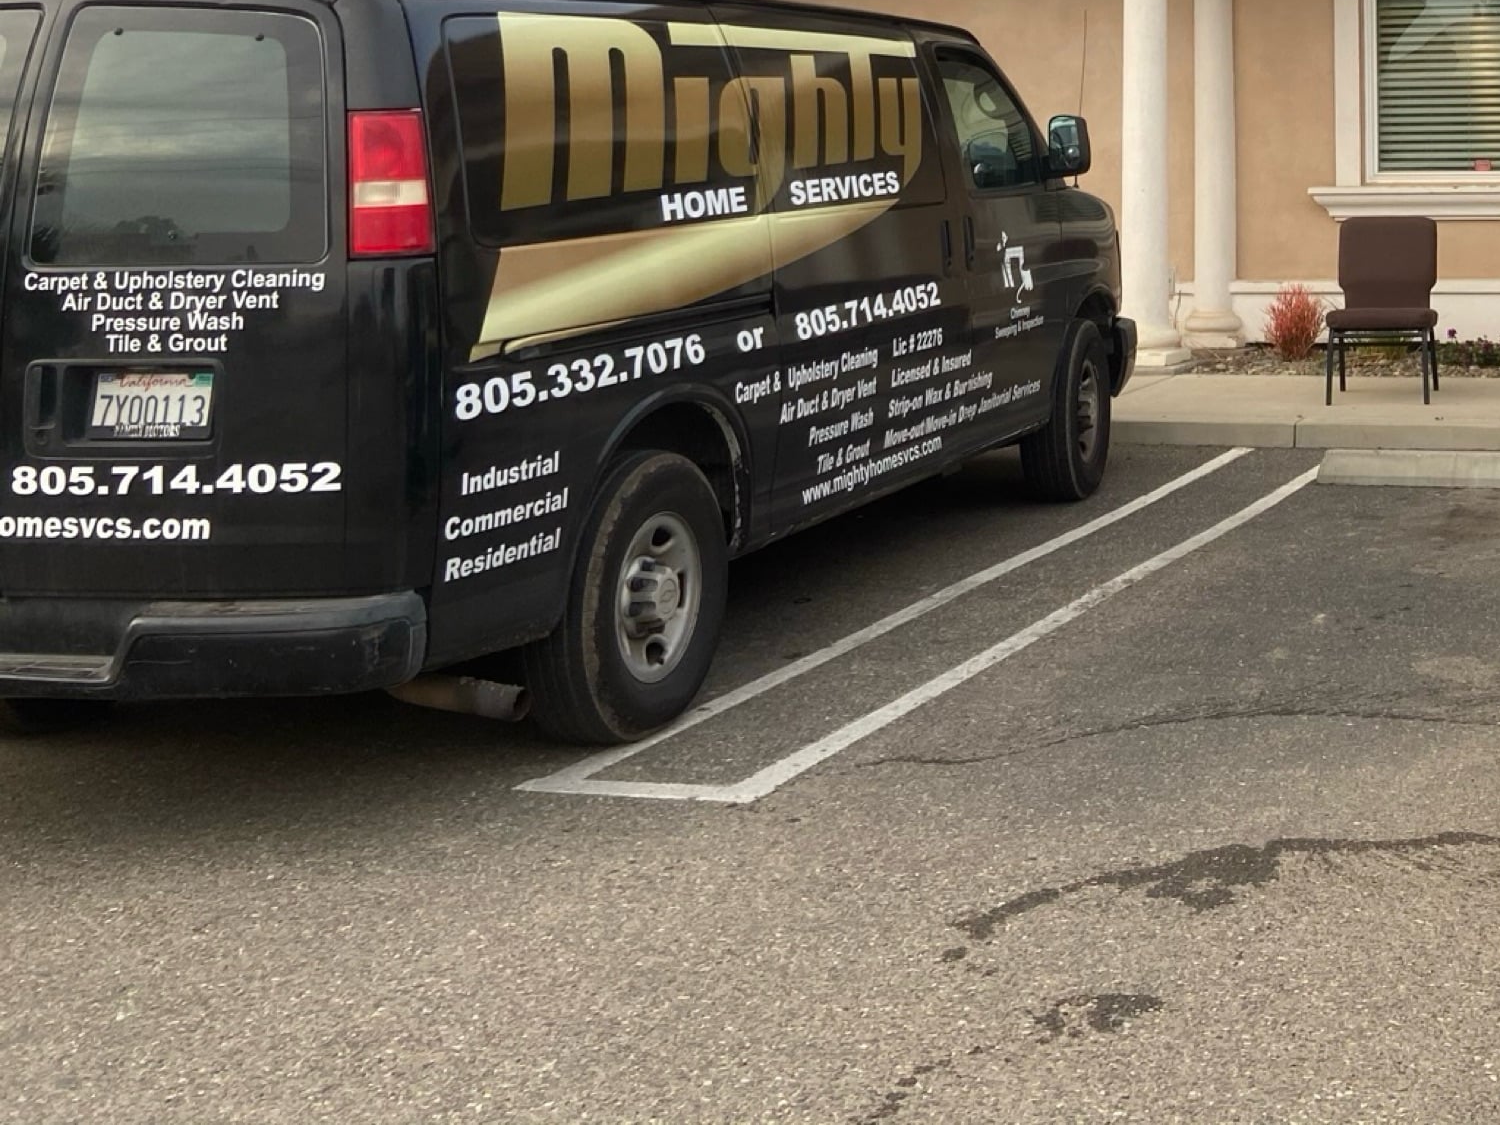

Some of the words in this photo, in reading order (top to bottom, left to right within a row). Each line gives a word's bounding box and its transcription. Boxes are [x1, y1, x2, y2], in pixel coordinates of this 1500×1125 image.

[661, 186, 747, 221] HOME
[790, 171, 900, 206] SERVICES
[24, 272, 89, 293] Carpet
[94, 272, 108, 290] &
[115, 271, 225, 292] Upholstery
[231, 269, 326, 291] Cleaning
[62, 293, 91, 311] Air
[97, 292, 143, 310] Duct
[149, 292, 164, 309] &
[170, 293, 227, 315] Dryer
[232, 291, 279, 309] Vent
[91, 314, 181, 332] Pressure
[188, 313, 244, 331] Wash
[105, 334, 142, 353] Tile
[147, 334, 162, 352] &
[169, 334, 228, 352] Grout
[455, 334, 706, 420] 805.332.7076
[737, 326, 764, 352] or
[795, 281, 942, 340] 805.714.4052
[893, 337, 907, 357] Lic
[909, 335, 915, 353] #
[917, 328, 942, 351] 22276
[735, 377, 770, 404] Carpet
[773, 371, 781, 391] &
[788, 359, 839, 391] Upholstery
[841, 346, 878, 372] Cleaning
[891, 359, 932, 387] Licensed
[933, 357, 940, 374] &
[942, 349, 972, 372] Insured
[100, 394, 206, 426] 7Y00113
[779, 402, 794, 424] Air
[797, 395, 820, 419] Duct
[821, 391, 828, 409] &
[831, 385, 855, 410] Dryer
[857, 376, 877, 398] Vent
[888, 394, 923, 419] Strip-on
[925, 386, 943, 406] Wax
[808, 419, 849, 447] Pressure
[850, 407, 874, 431] Wash
[461, 451, 559, 495] Industrial
[802, 436, 942, 505] www.mightyhomesvcs.com
[817, 454, 833, 475] Tile
[847, 438, 871, 464] Grout
[12, 462, 342, 495] 805.714.4052
[0, 515, 210, 540] omesvcs.com
[444, 488, 568, 540] Commercial
[444, 527, 561, 582] Residential
